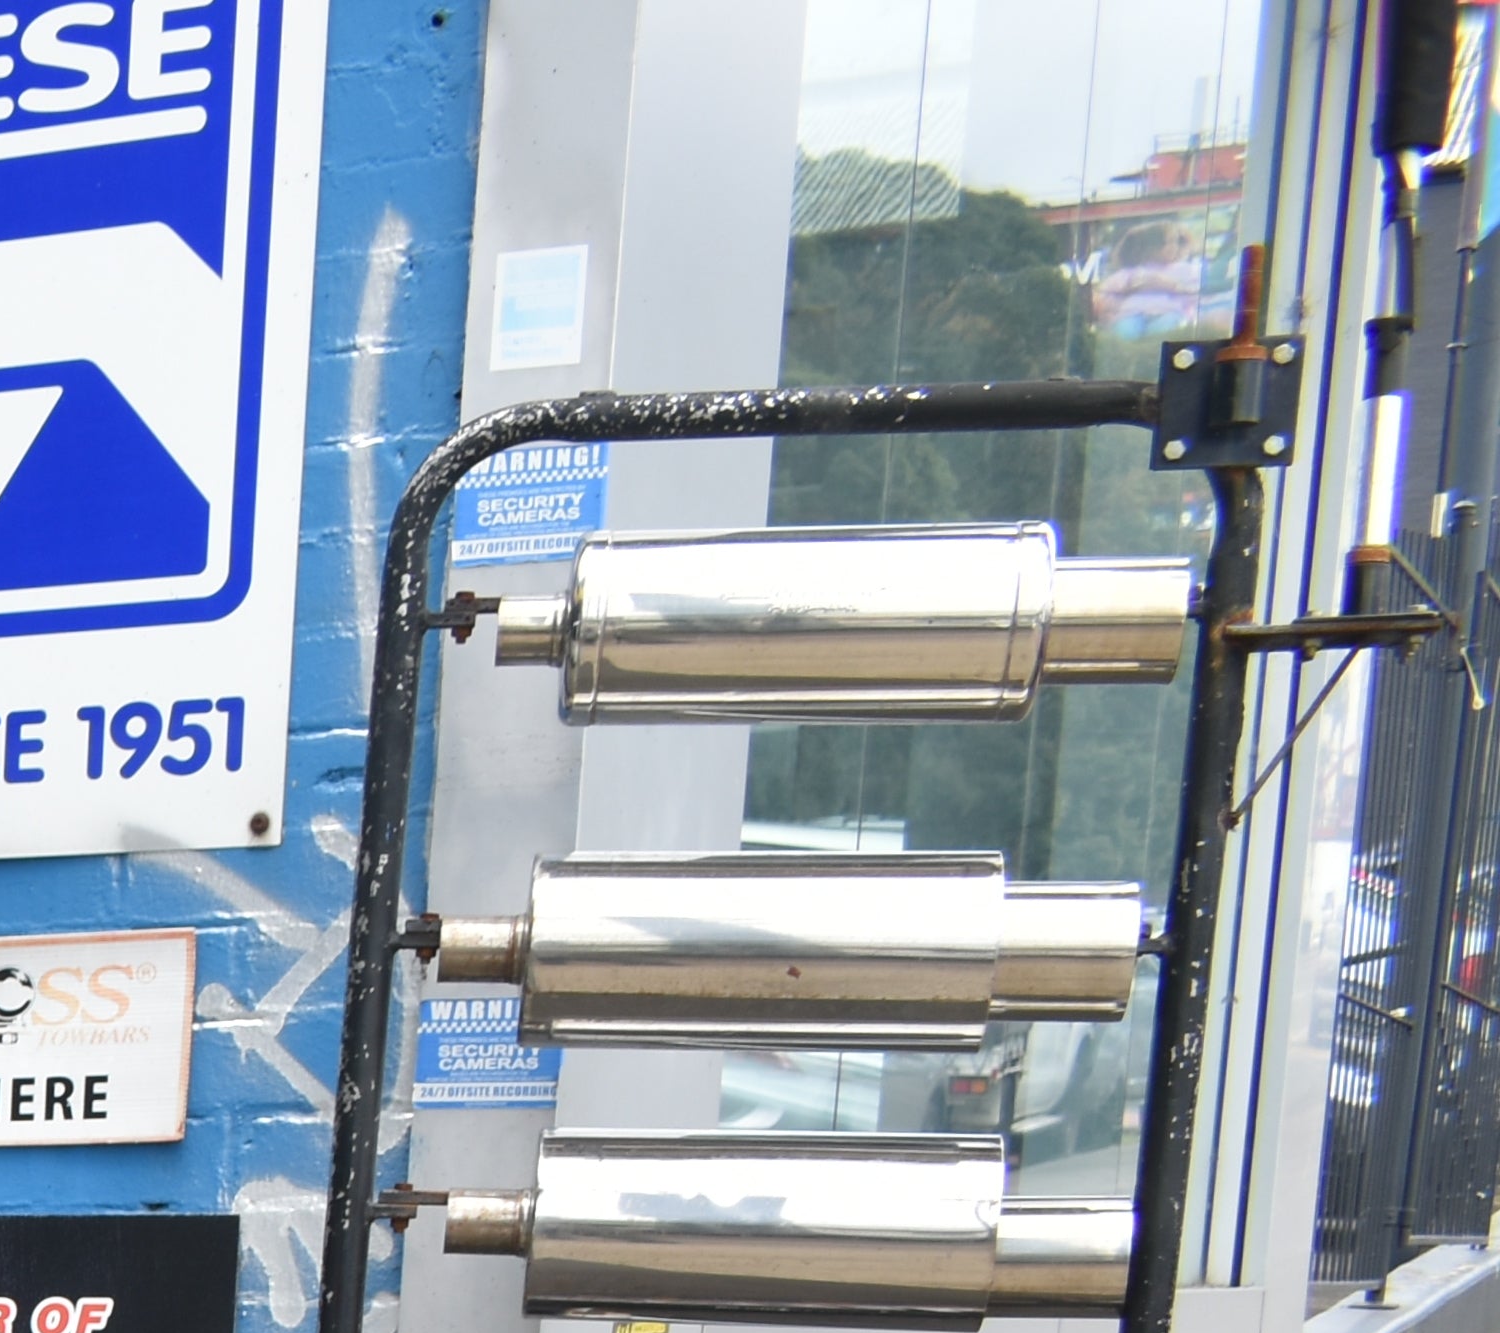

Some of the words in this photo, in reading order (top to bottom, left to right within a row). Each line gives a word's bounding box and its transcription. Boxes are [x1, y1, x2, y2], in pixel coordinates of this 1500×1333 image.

[477, 492, 584, 514] SECURITY
[477, 507, 581, 527] CAMERAS
[487, 540, 531, 554] OFFSITE
[77, 697, 245, 781] 1951
[438, 1043, 540, 1058] SECURITY
[438, 1057, 539, 1071] CAMERAS
[447, 1086, 490, 1098] OFFSITE
